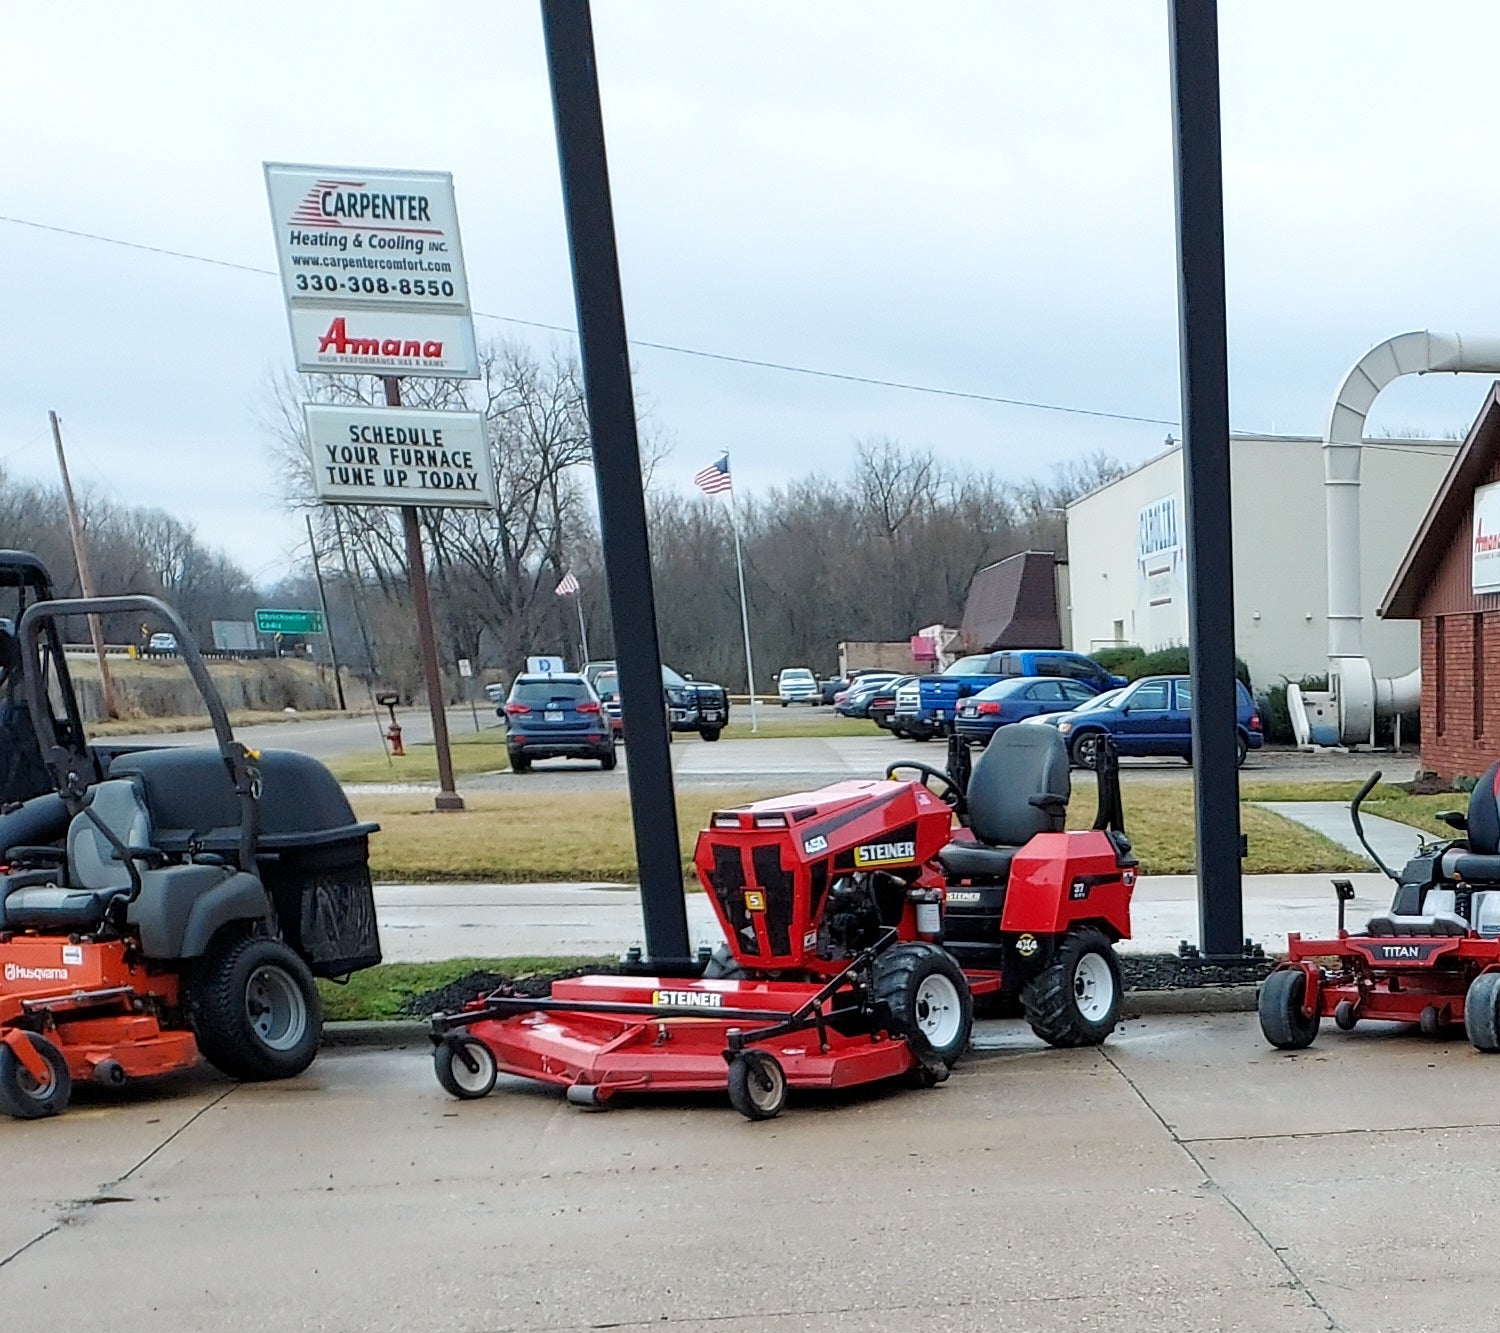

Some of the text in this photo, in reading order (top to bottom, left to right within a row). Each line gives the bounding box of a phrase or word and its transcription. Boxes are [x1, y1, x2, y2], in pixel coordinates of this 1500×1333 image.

[321, 190, 431, 222] CARPENTER
[289, 230, 449, 255] Heating & Cooling INC.
[291, 254, 452, 274] www.carpentercomfort.com
[296, 273, 455, 298] 330-308-8550
[318, 317, 443, 359] Amana
[349, 424, 444, 448] SCHEDULE
[325, 444, 473, 469] YOUR FURNACE
[325, 466, 478, 490] TUNE UP TODAY
[804, 835, 828, 854] 450
[859, 841, 916, 861] STEINER
[946, 892, 981, 902] STEINER
[1382, 946, 1420, 958] TITAN
[15, 965, 69, 981] Husqvarna
[658, 990, 722, 1007] STEINER
